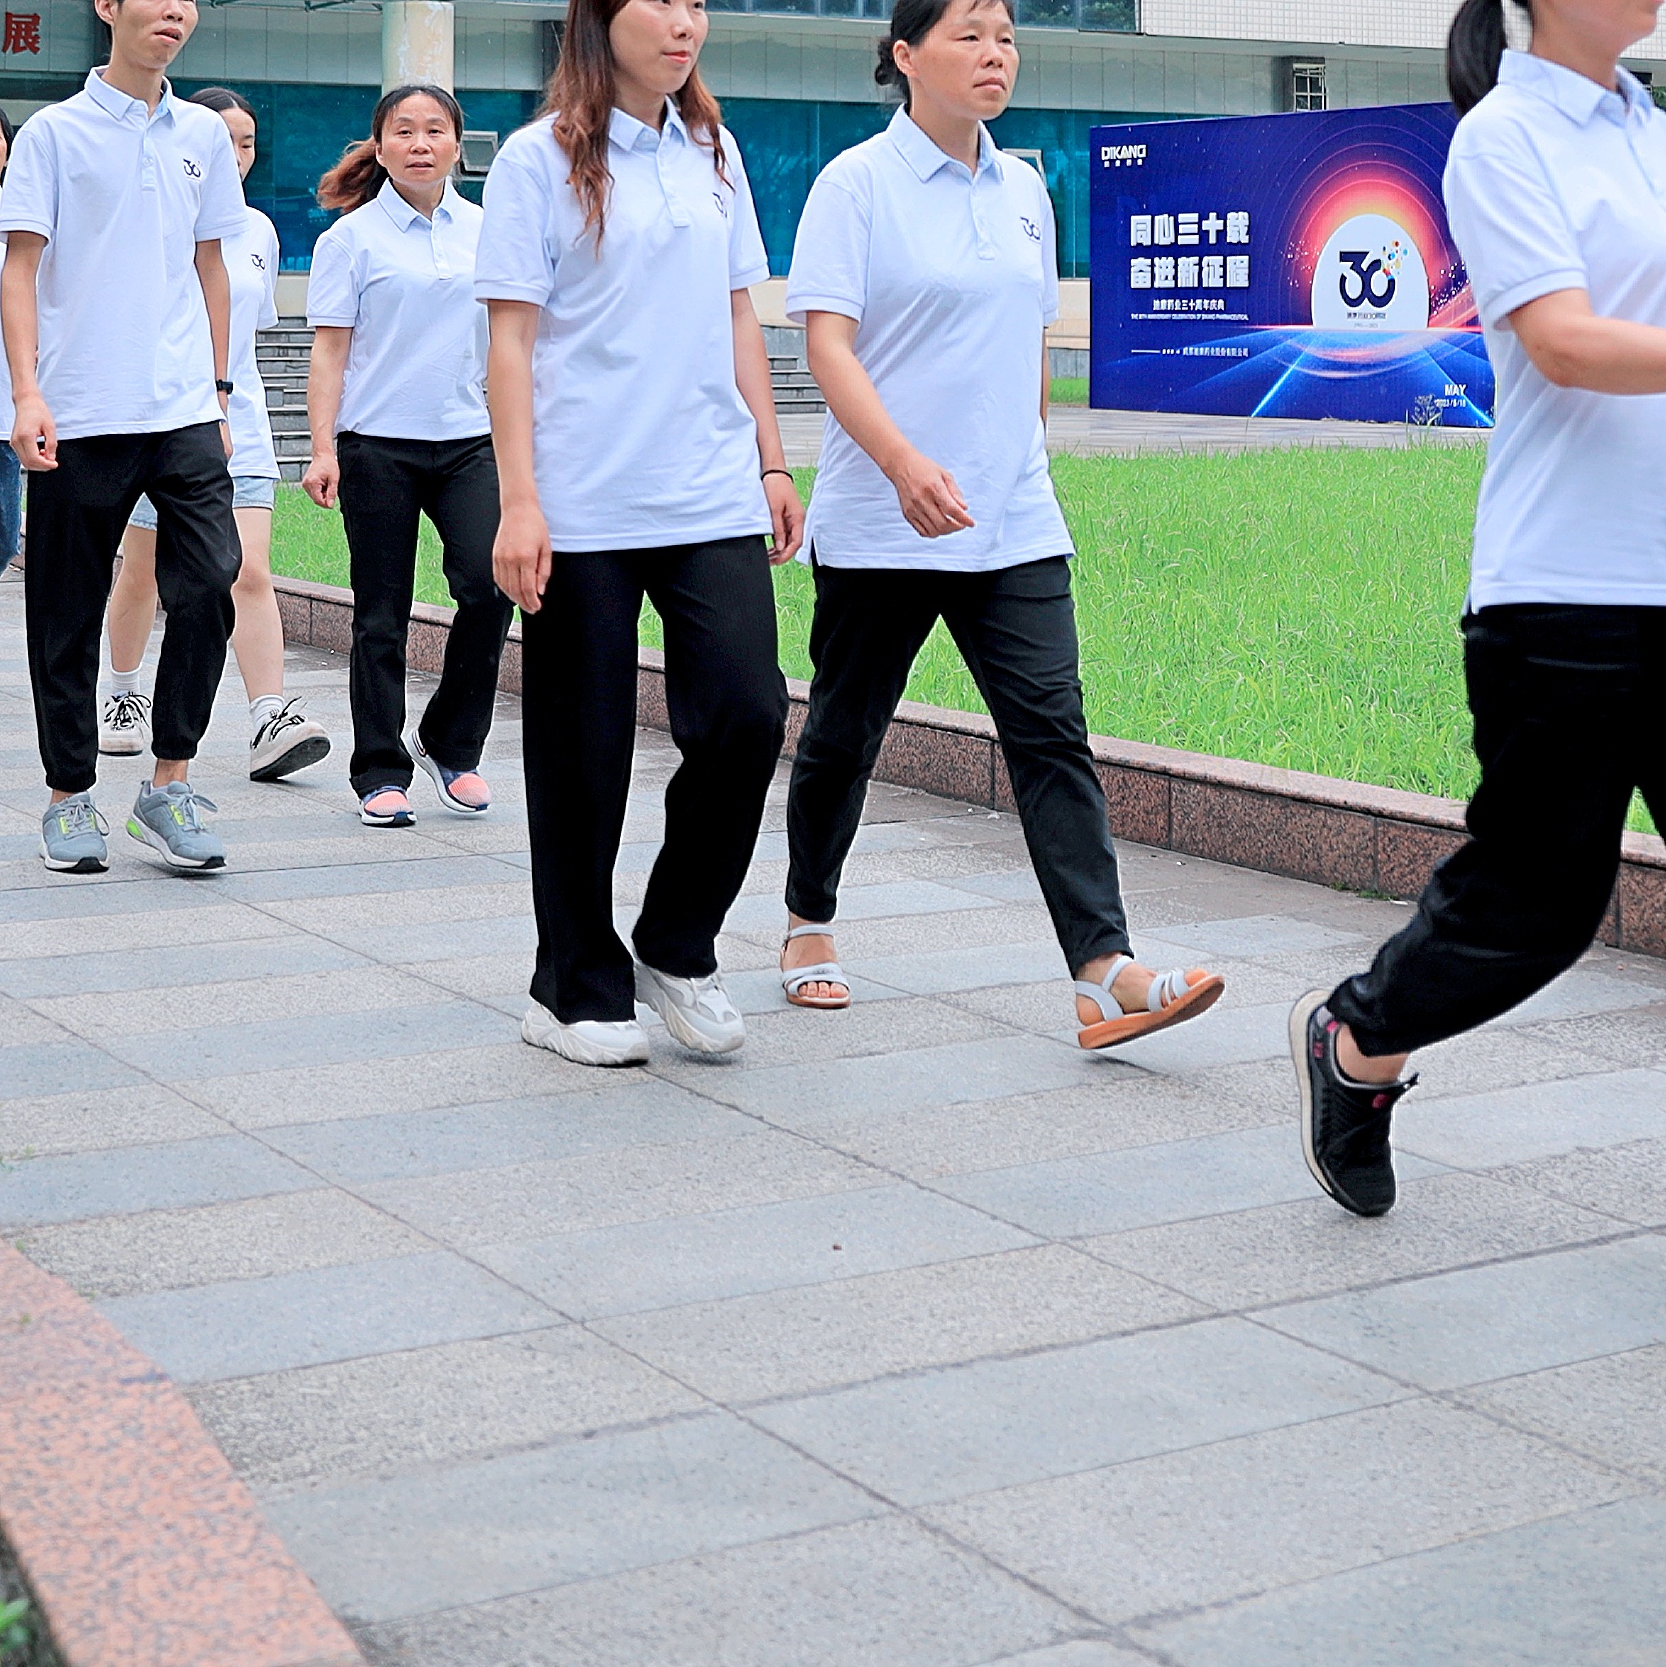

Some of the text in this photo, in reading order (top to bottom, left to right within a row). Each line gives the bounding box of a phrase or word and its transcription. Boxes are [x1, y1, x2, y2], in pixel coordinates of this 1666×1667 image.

[1101, 144, 1147, 160] DIKANG
[1130, 212, 1250, 246] 同心三十载
[1130, 255, 1250, 289] 奋进新征程
[1339, 250, 1396, 308] 30
[1444, 384, 1467, 396] MAY
